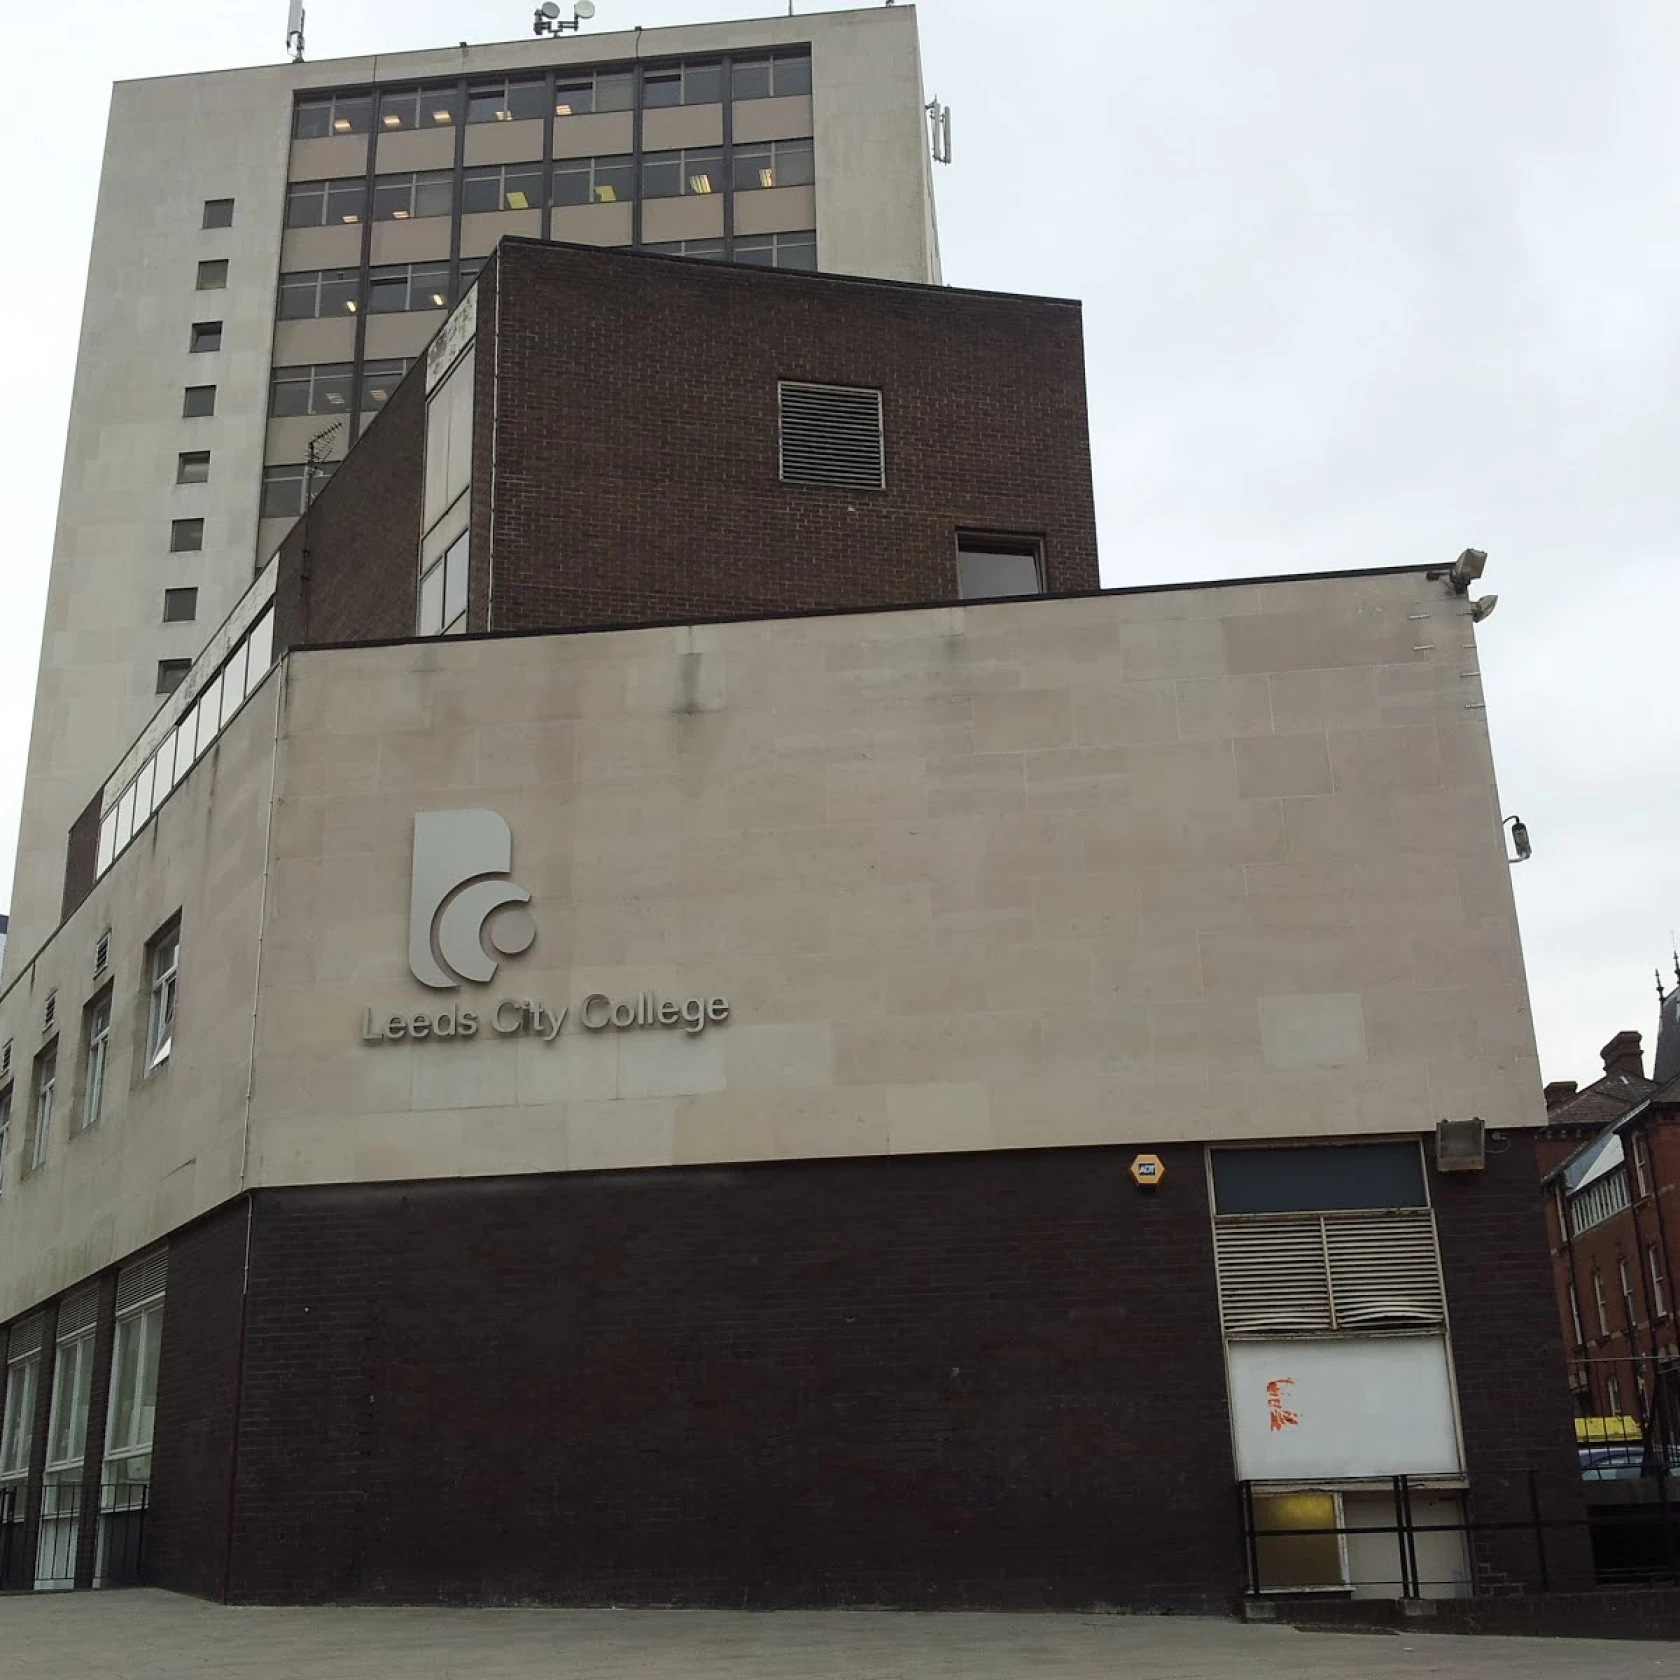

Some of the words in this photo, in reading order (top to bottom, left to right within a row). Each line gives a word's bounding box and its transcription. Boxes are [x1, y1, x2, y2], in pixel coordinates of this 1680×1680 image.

[361, 1004, 478, 1041] Leeds
[491, 998, 568, 1041] City
[580, 990, 730, 1033] College
[1138, 1164, 1155, 1174] ADT
